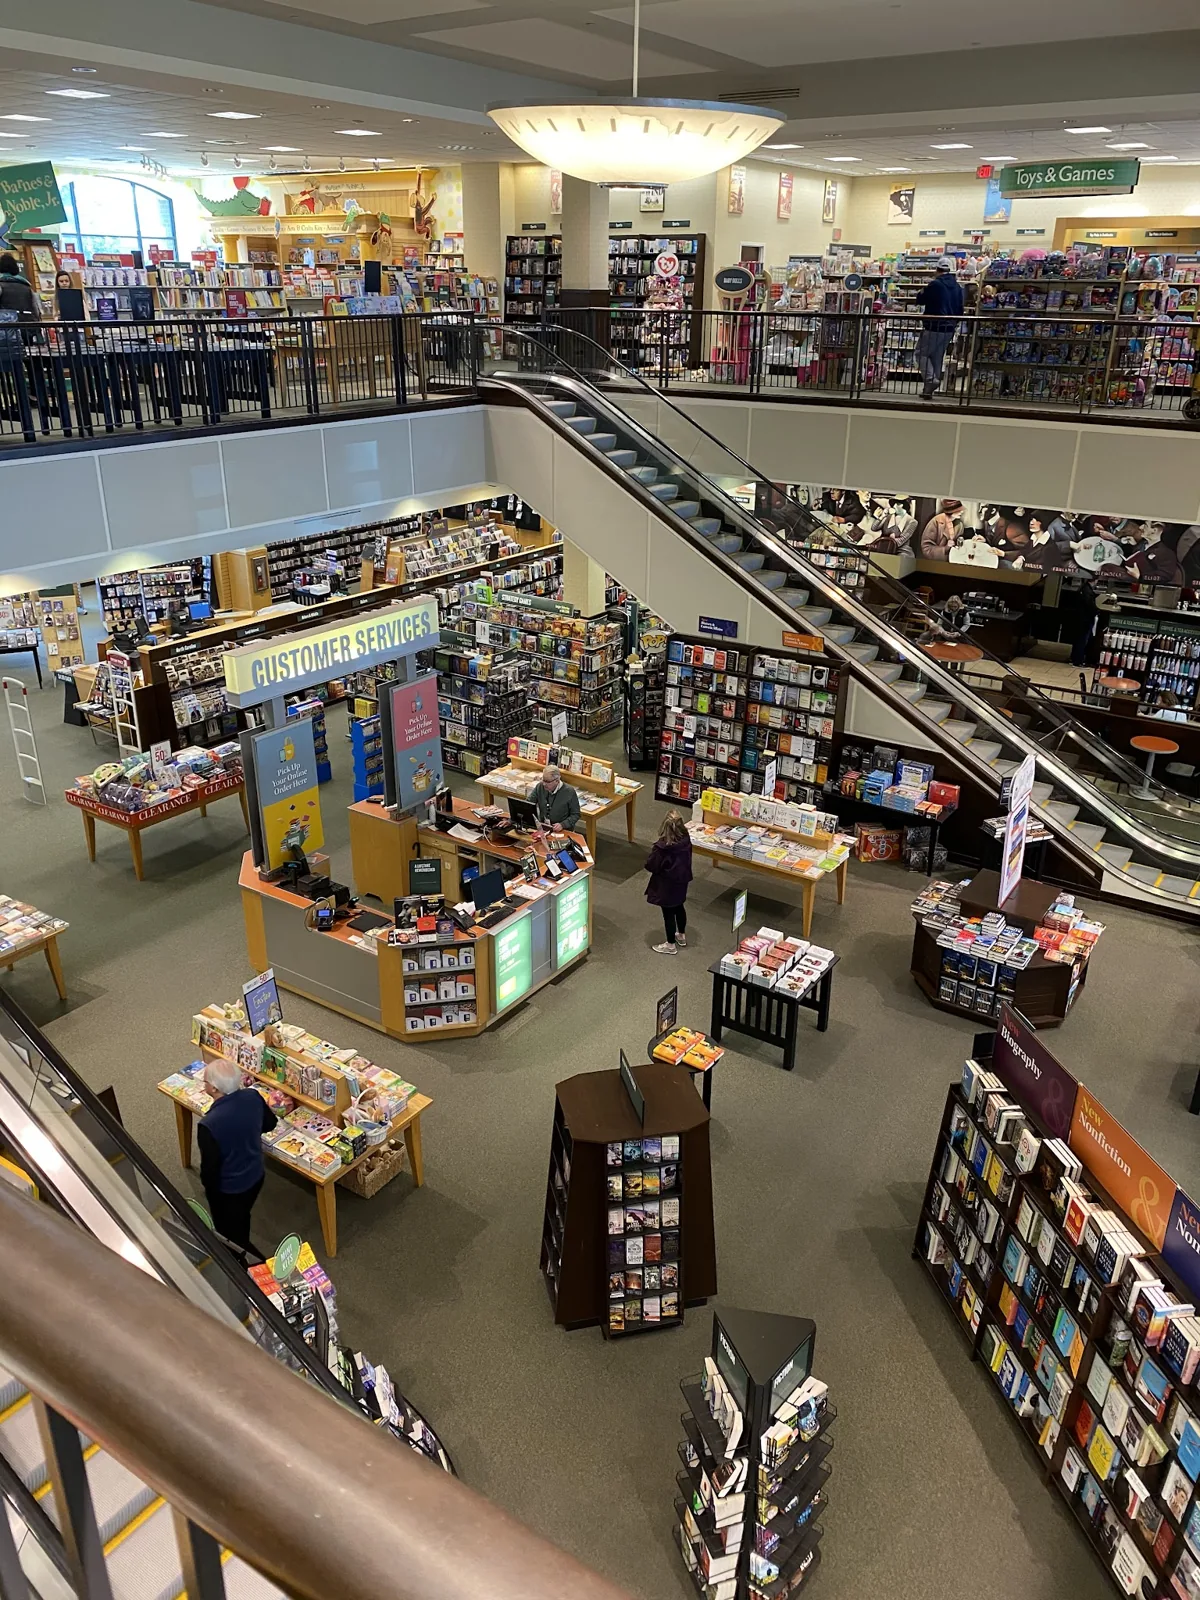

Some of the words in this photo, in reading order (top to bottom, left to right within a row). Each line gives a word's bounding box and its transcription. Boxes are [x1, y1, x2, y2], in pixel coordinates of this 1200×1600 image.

[1, 176, 42, 194] Barnes
[43, 175, 54, 188] &
[1014, 168, 1043, 189] Toys
[1044, 166, 1057, 182] &
[1058, 165, 1116, 182] Games
[5, 196, 45, 214] Noble,
[44, 191, 60, 207] Jr.
[251, 634, 351, 688] CUSTOMER
[355, 610, 431, 657] SERVICES
[404, 727, 416, 735] Your
[416, 719, 433, 729] Online
[409, 715, 420, 726] Pick
[419, 713, 428, 722] Up
[405, 732, 420, 742] Order
[420, 727, 433, 737] Here
[272, 777, 287, 787] Your
[287, 769, 308, 781] Online
[277, 765, 291, 777] Pick
[291, 762, 301, 771] Up
[273, 783, 293, 796] Order
[292, 777, 308, 788] Here
[98, 808, 131, 824] CLEARANCE
[138, 793, 192, 821] CLEARANCE
[252, 991, 272, 1010] Easter
[1003, 1011, 1021, 1038] New
[1000, 1025, 1043, 1080] Biography
[1080, 1096, 1103, 1128] New
[1078, 1111, 1132, 1178] Nonfiction
[280, 1243, 293, 1262] MINI
[281, 1253, 294, 1271] KITS
[720, 1332, 736, 1366] FICTION
[773, 1359, 794, 1389] FICTION
